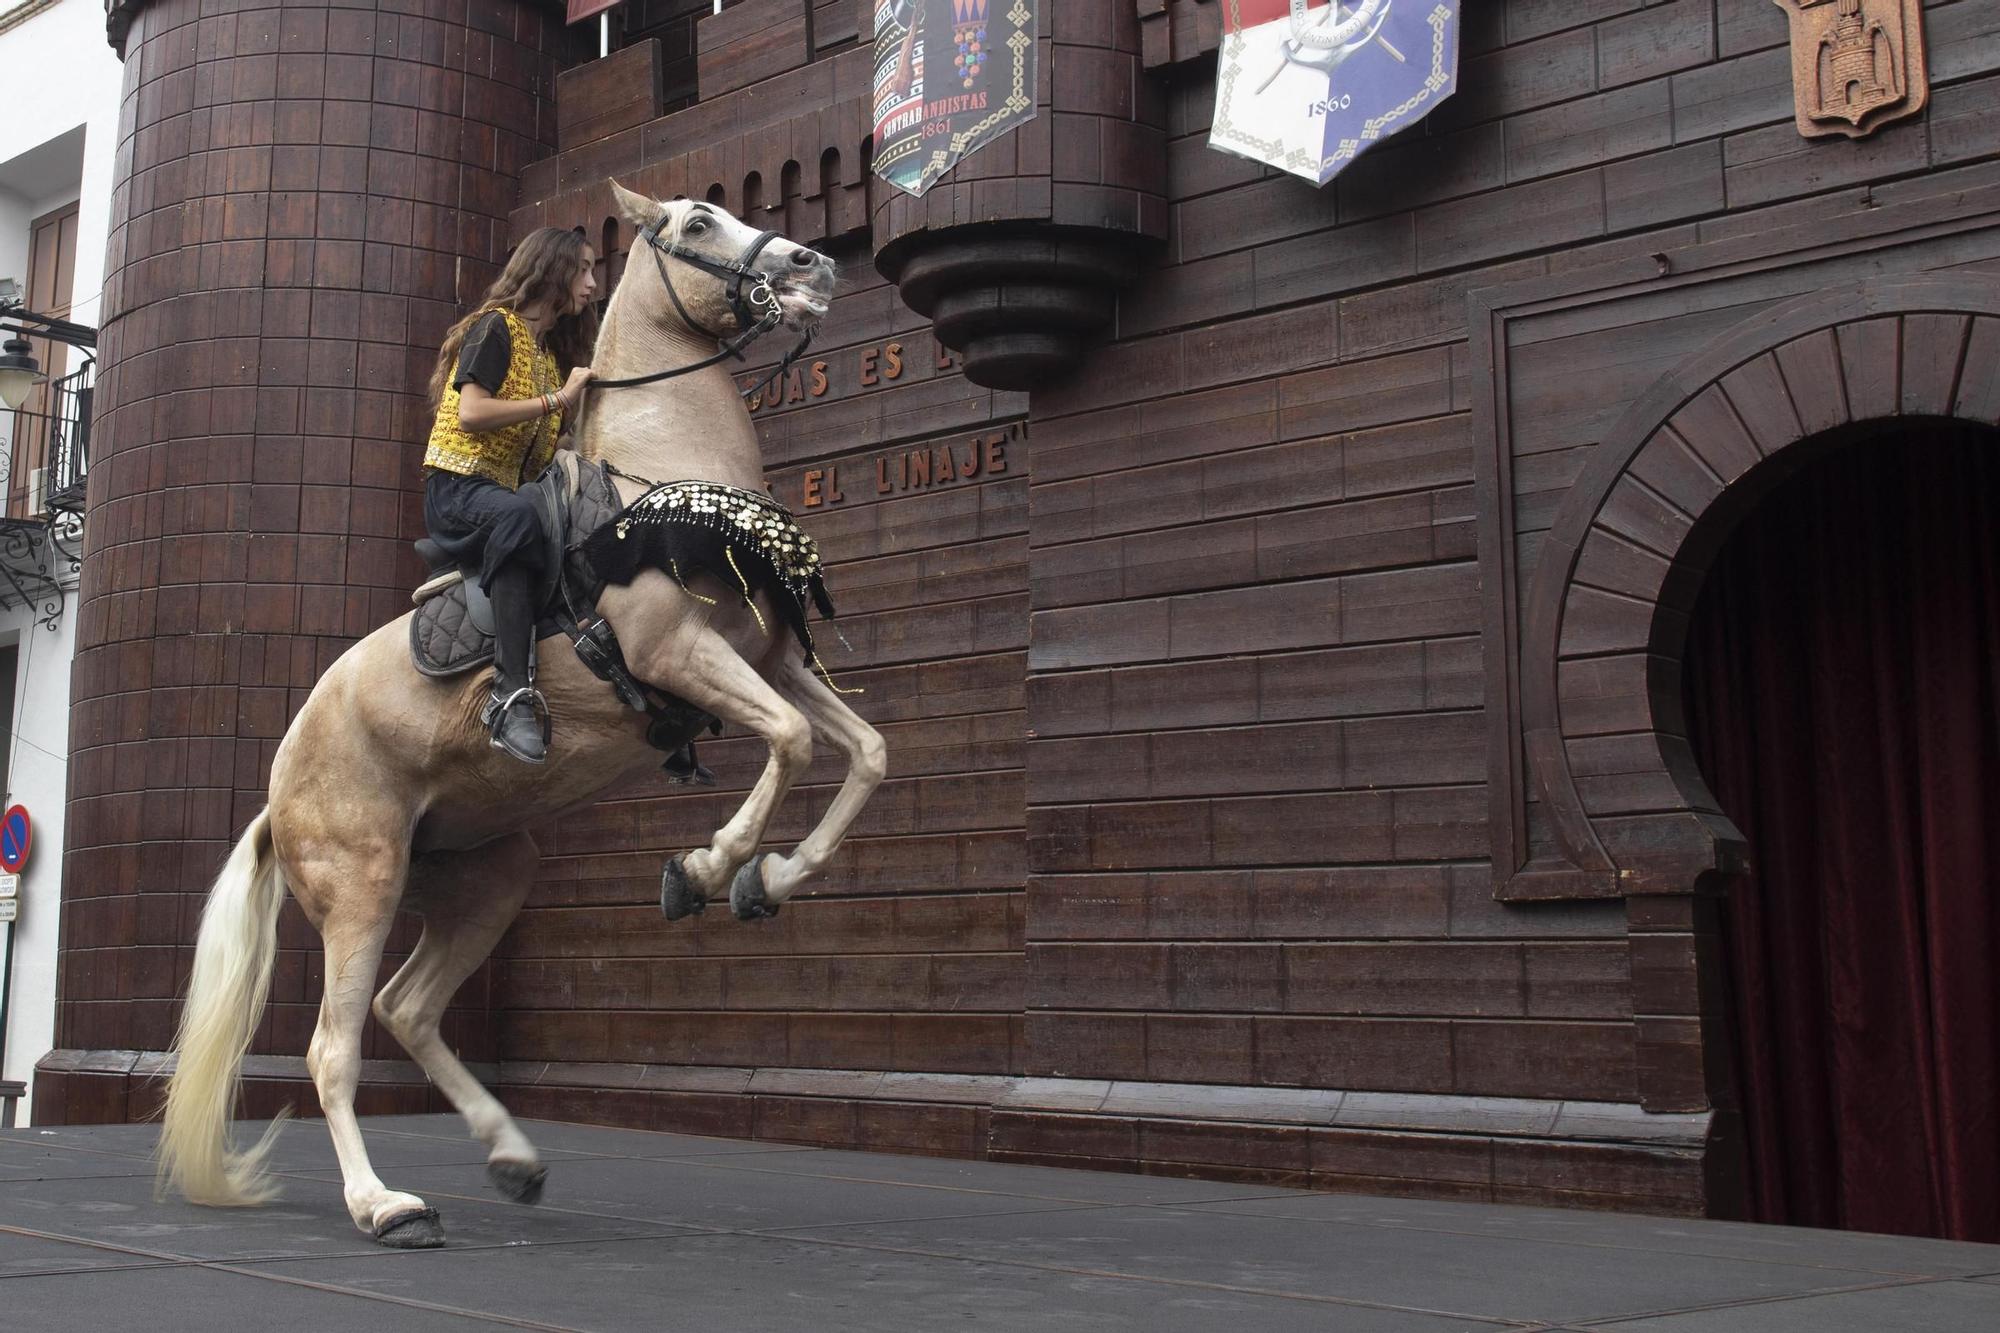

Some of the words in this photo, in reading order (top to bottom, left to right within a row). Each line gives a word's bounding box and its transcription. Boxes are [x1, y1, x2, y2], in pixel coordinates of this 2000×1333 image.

[883, 91, 988, 140] CONTRABANDISTAS
[1309, 94, 1351, 118] 1860
[921, 118, 952, 140] 1861
[861, 343, 902, 387] ES
[803, 466, 844, 507] EL
